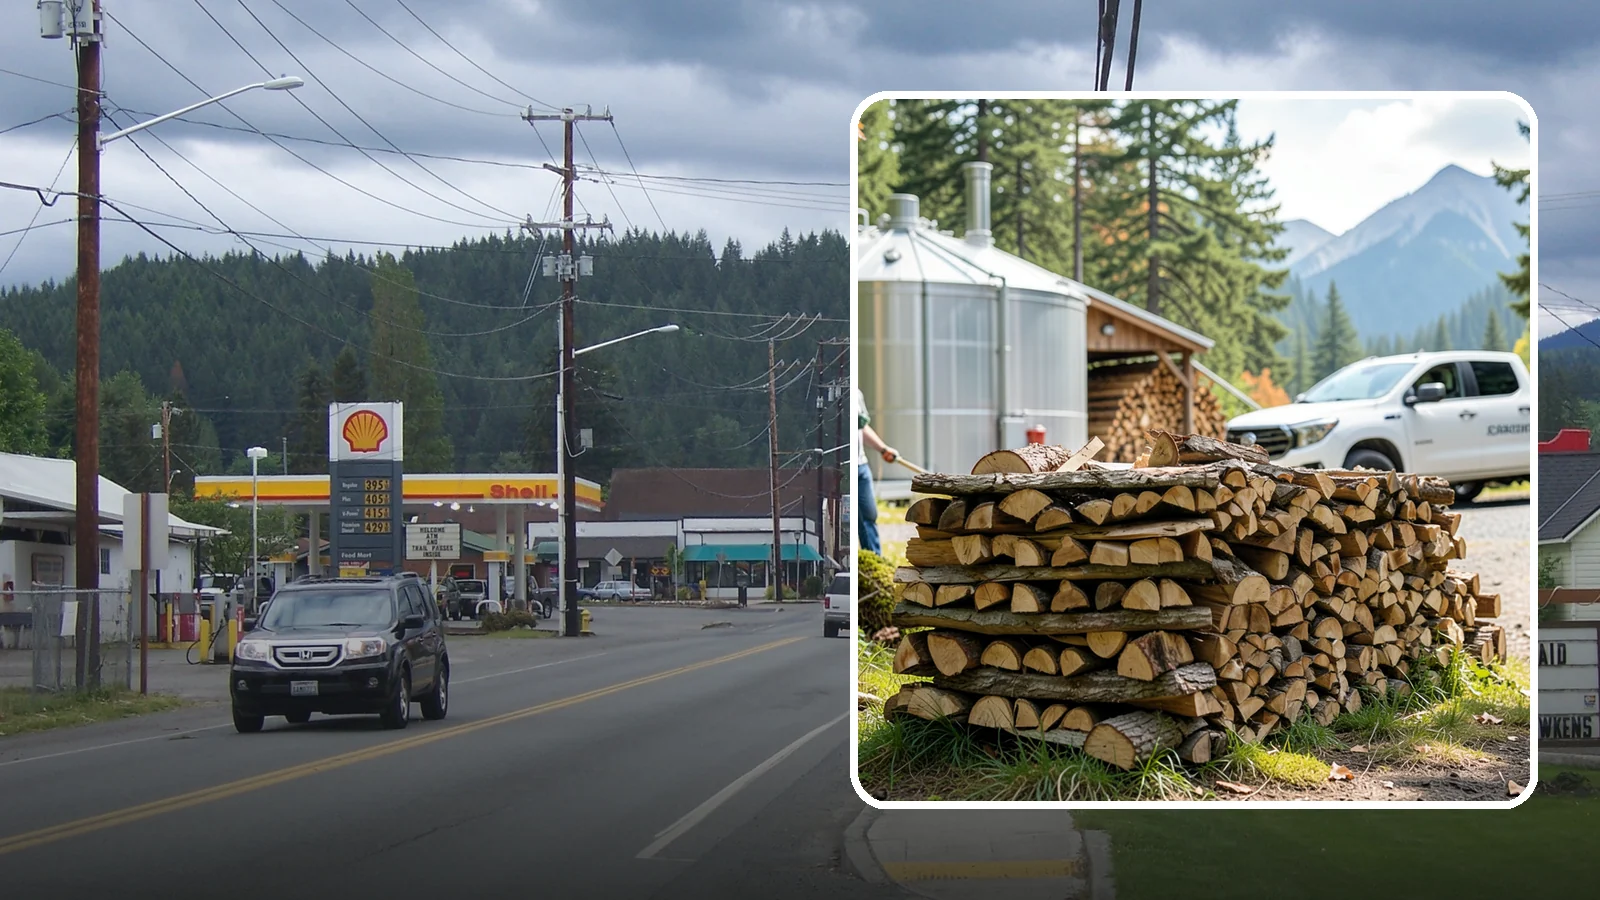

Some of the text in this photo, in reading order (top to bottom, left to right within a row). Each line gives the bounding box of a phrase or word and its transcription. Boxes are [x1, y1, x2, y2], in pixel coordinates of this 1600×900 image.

[366, 480, 384, 490] 395
[490, 484, 547, 499] Shell
[366, 494, 384, 504] 405
[366, 508, 384, 518] 415
[366, 522, 384, 532] 429
